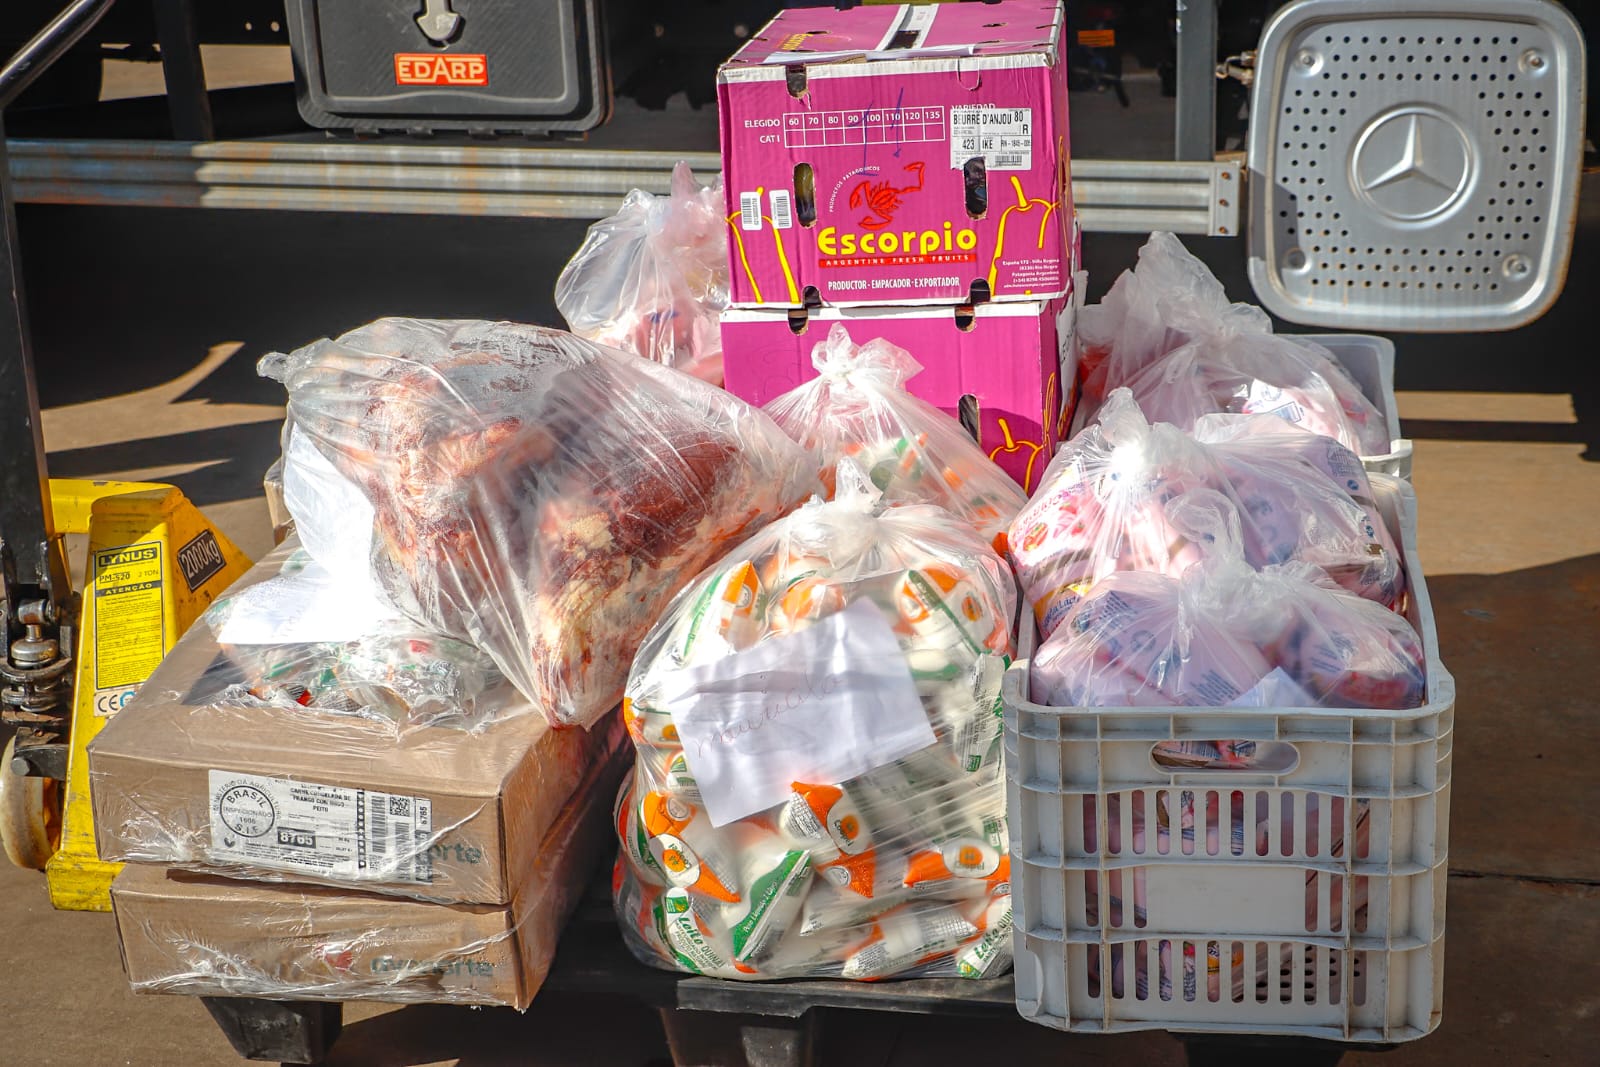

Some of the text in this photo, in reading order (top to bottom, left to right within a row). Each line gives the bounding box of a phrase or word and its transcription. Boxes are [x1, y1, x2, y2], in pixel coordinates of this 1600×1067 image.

[398, 57, 485, 83] EDARP
[744, 111, 941, 128] ELEGIDO 60 70 80 90 100 110 120 135
[982, 113, 1012, 125] D'ANJOU
[1014, 111, 1024, 122] 80
[1022, 124, 1029, 135] R
[759, 135, 775, 144] CAT
[962, 139, 975, 150] 423
[982, 139, 993, 150] IKE
[828, 181, 844, 213] PRODUCTOS
[817, 221, 977, 255] Escorpio
[825, 254, 969, 266] ARGENTINE FRESH FRUITS
[827, 276, 960, 292] PRODUCTOR EMPACADOR EXPORTADOR
[100, 549, 155, 565] LYNUS
[180, 536, 222, 579] 2000kg
[226, 789, 267, 808] BRASIL
[280, 832, 314, 846] 8765
